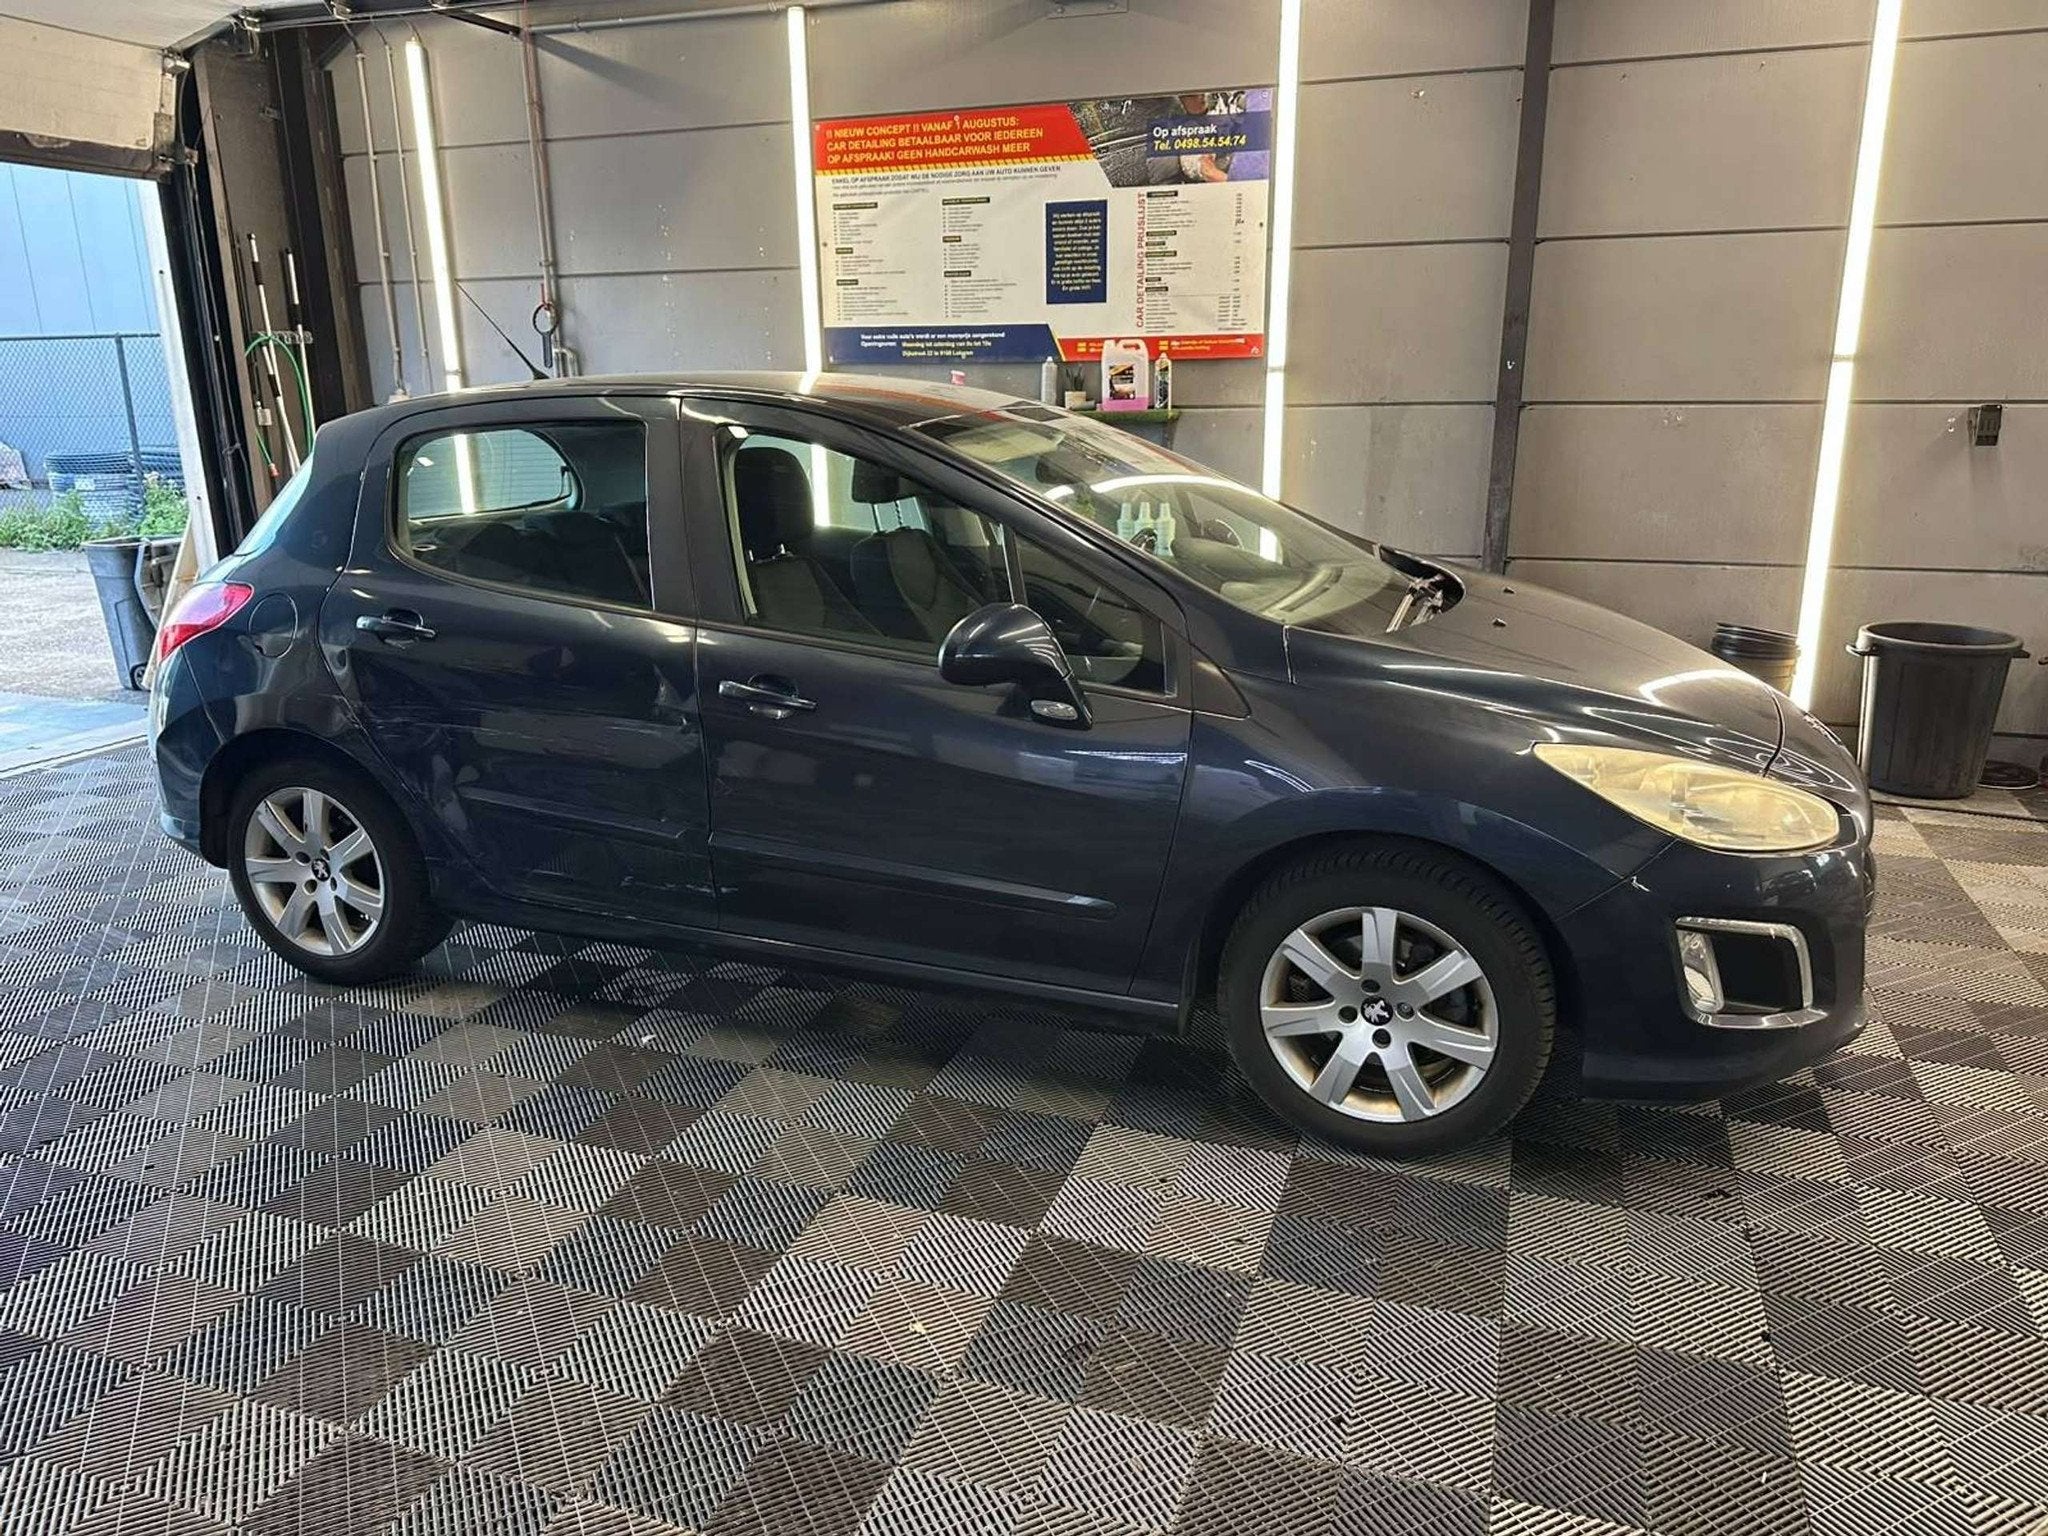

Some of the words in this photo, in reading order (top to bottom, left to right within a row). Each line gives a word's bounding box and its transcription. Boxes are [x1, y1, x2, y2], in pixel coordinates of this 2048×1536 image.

[834, 127, 864, 138] NIEUW
[866, 125, 911, 136] CONCEPT
[921, 121, 953, 132] VANAF
[962, 116, 1020, 129] AUGUSTUS:
[1153, 127, 1169, 138] Op
[1171, 123, 1218, 137] afspraak
[826, 141, 847, 152] CAR
[848, 138, 896, 150] DETAILING
[898, 134, 961, 147] BETAALBAAR
[964, 131, 992, 142] VOOR
[994, 128, 1044, 140] IEDEREEN
[1154, 140, 1172, 151] Tel.
[1174, 134, 1247, 149] 0498.54.54.74
[827, 154, 841, 165] OP
[842, 151, 895, 163] AFSPRAAK!
[896, 149, 923, 160] GEEN
[924, 144, 1000, 158] HANDCARWASH
[1002, 142, 1030, 153] MEER
[1136, 251, 1145, 304] DETAILING
[1136, 306, 1144, 328] CAR
